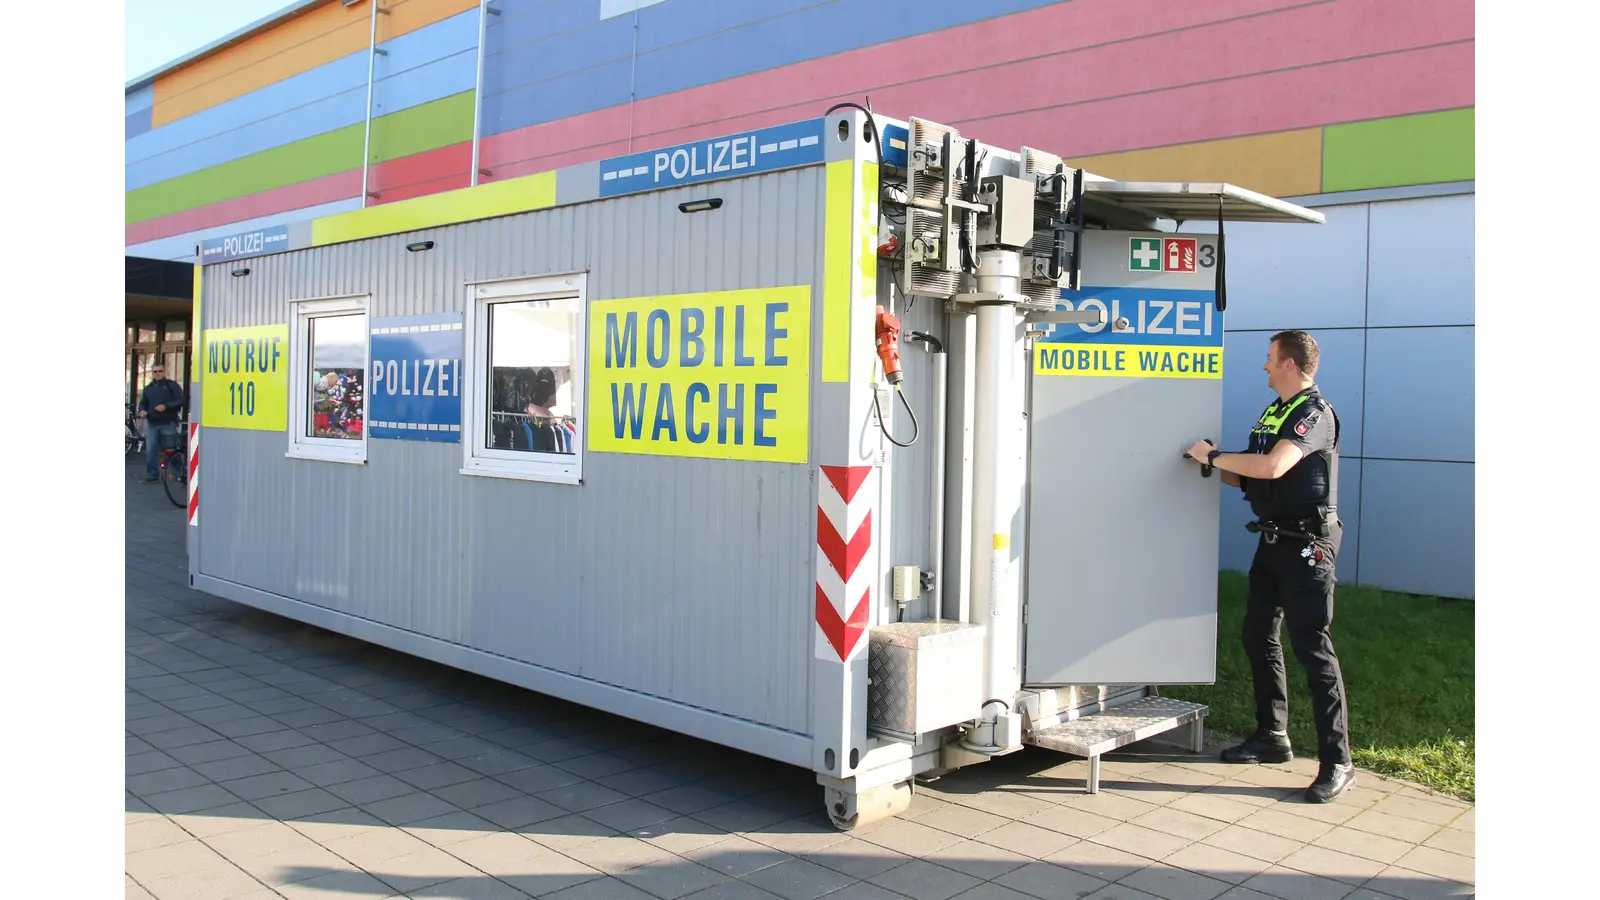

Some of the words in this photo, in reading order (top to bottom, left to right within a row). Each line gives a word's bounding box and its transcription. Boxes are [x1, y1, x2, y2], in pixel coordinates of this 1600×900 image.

[654, 135, 757, 182] POLIZEI
[223, 231, 264, 257] POLIZEI
[1198, 244, 1216, 268] 3
[604, 302, 789, 369] MOBILE
[208, 336, 281, 374] NOTRUF
[1040, 348, 1126, 371] MOBILE
[1138, 351, 1219, 374] WACHE
[372, 358, 459, 397] POLIZEI
[229, 381, 256, 417] 110
[610, 382, 778, 447] WACHE
